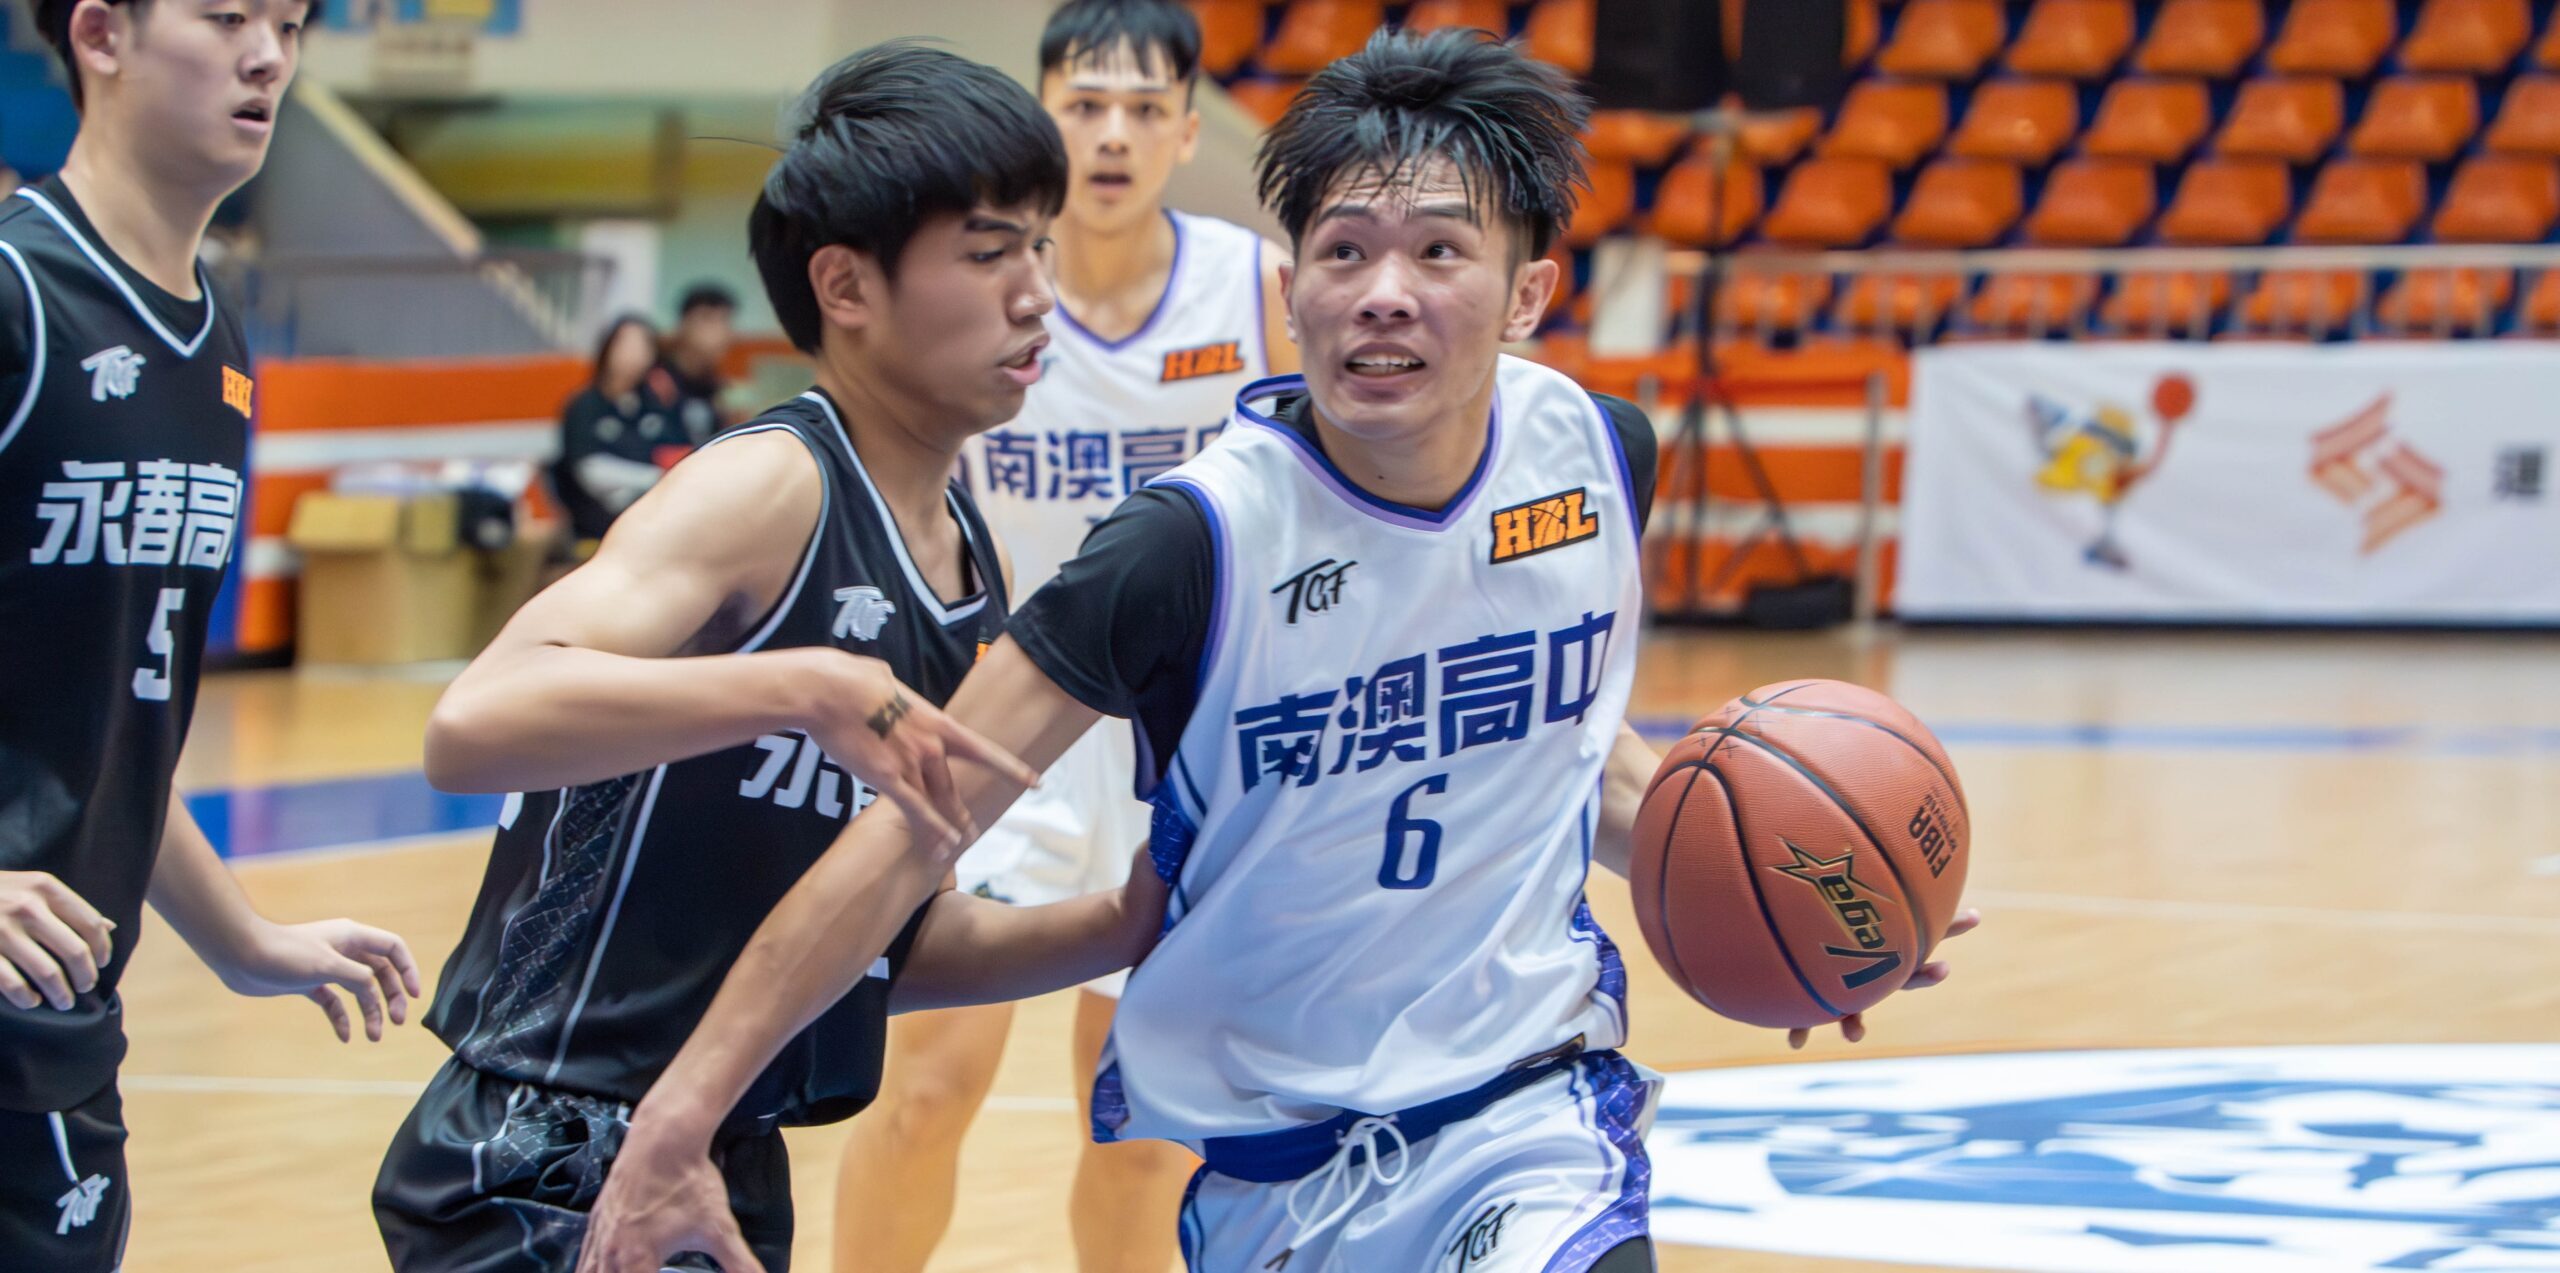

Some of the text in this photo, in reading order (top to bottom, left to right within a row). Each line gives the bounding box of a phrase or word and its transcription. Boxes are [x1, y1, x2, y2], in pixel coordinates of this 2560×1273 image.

[30, 458, 244, 571] 永春高
[1490, 488, 1598, 565] HBL
[131, 588, 186, 701] 5
[1271, 558, 1358, 625] TGF
[1234, 610, 1617, 795] 南澳高中
[1377, 773, 1452, 890] 6
[1909, 806, 1952, 879] FIBA
[1819, 873, 1902, 990] Vega
[1449, 1201, 1517, 1273] TGF
